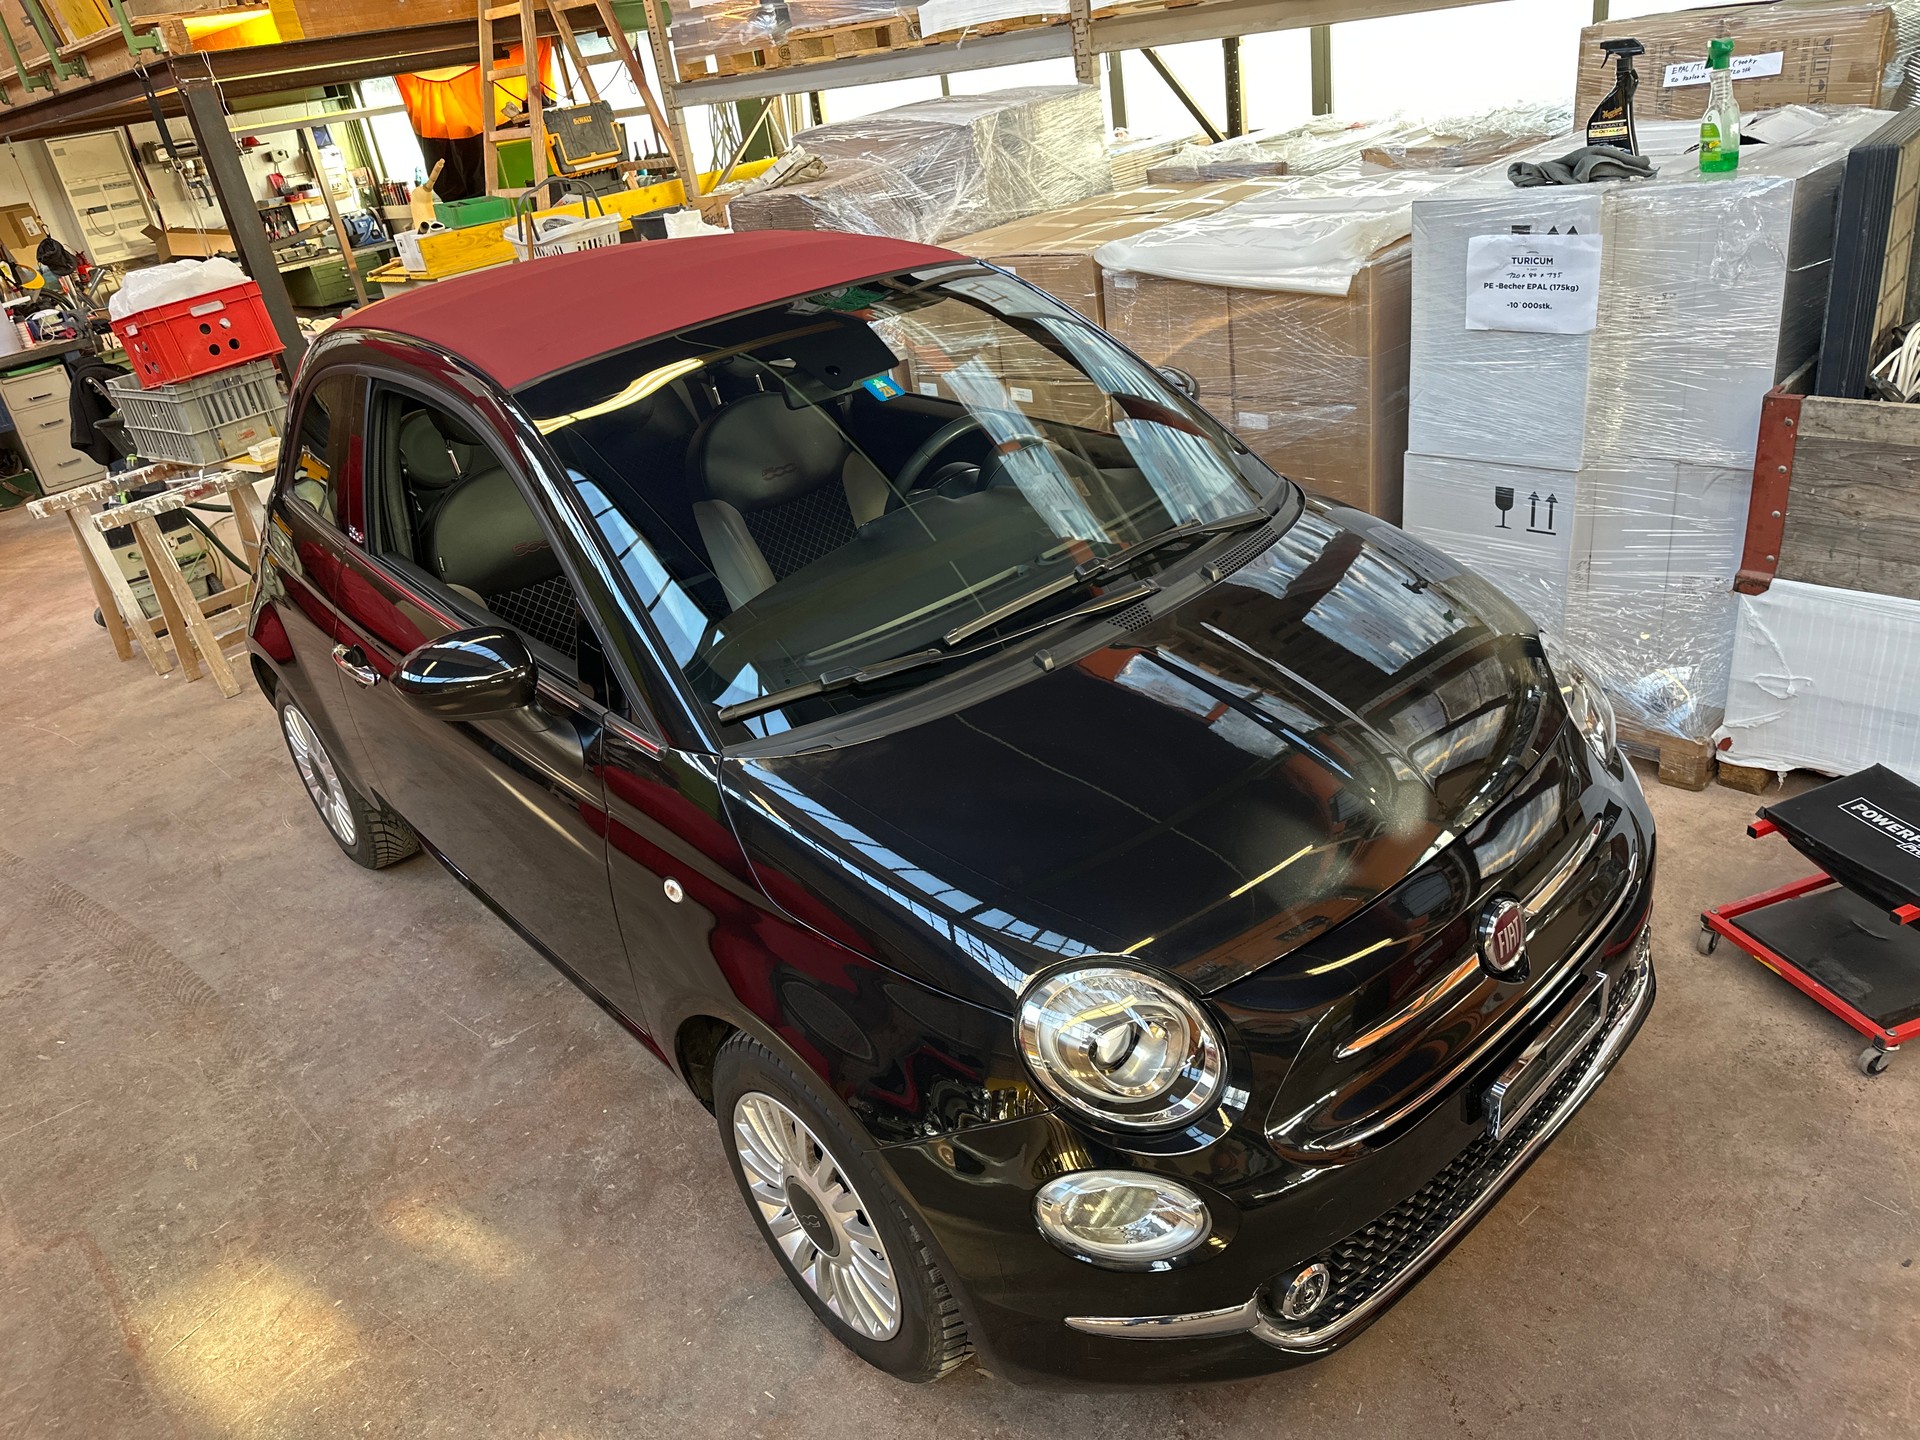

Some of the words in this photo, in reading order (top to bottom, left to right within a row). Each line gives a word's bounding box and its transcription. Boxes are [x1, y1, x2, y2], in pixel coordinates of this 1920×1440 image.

[1511, 256, 1554, 265] TURICUM
[1526, 283, 1548, 291] EPAL
[1549, 284, 1580, 292] (175kg)
[1497, 915, 1519, 959] FIAT
